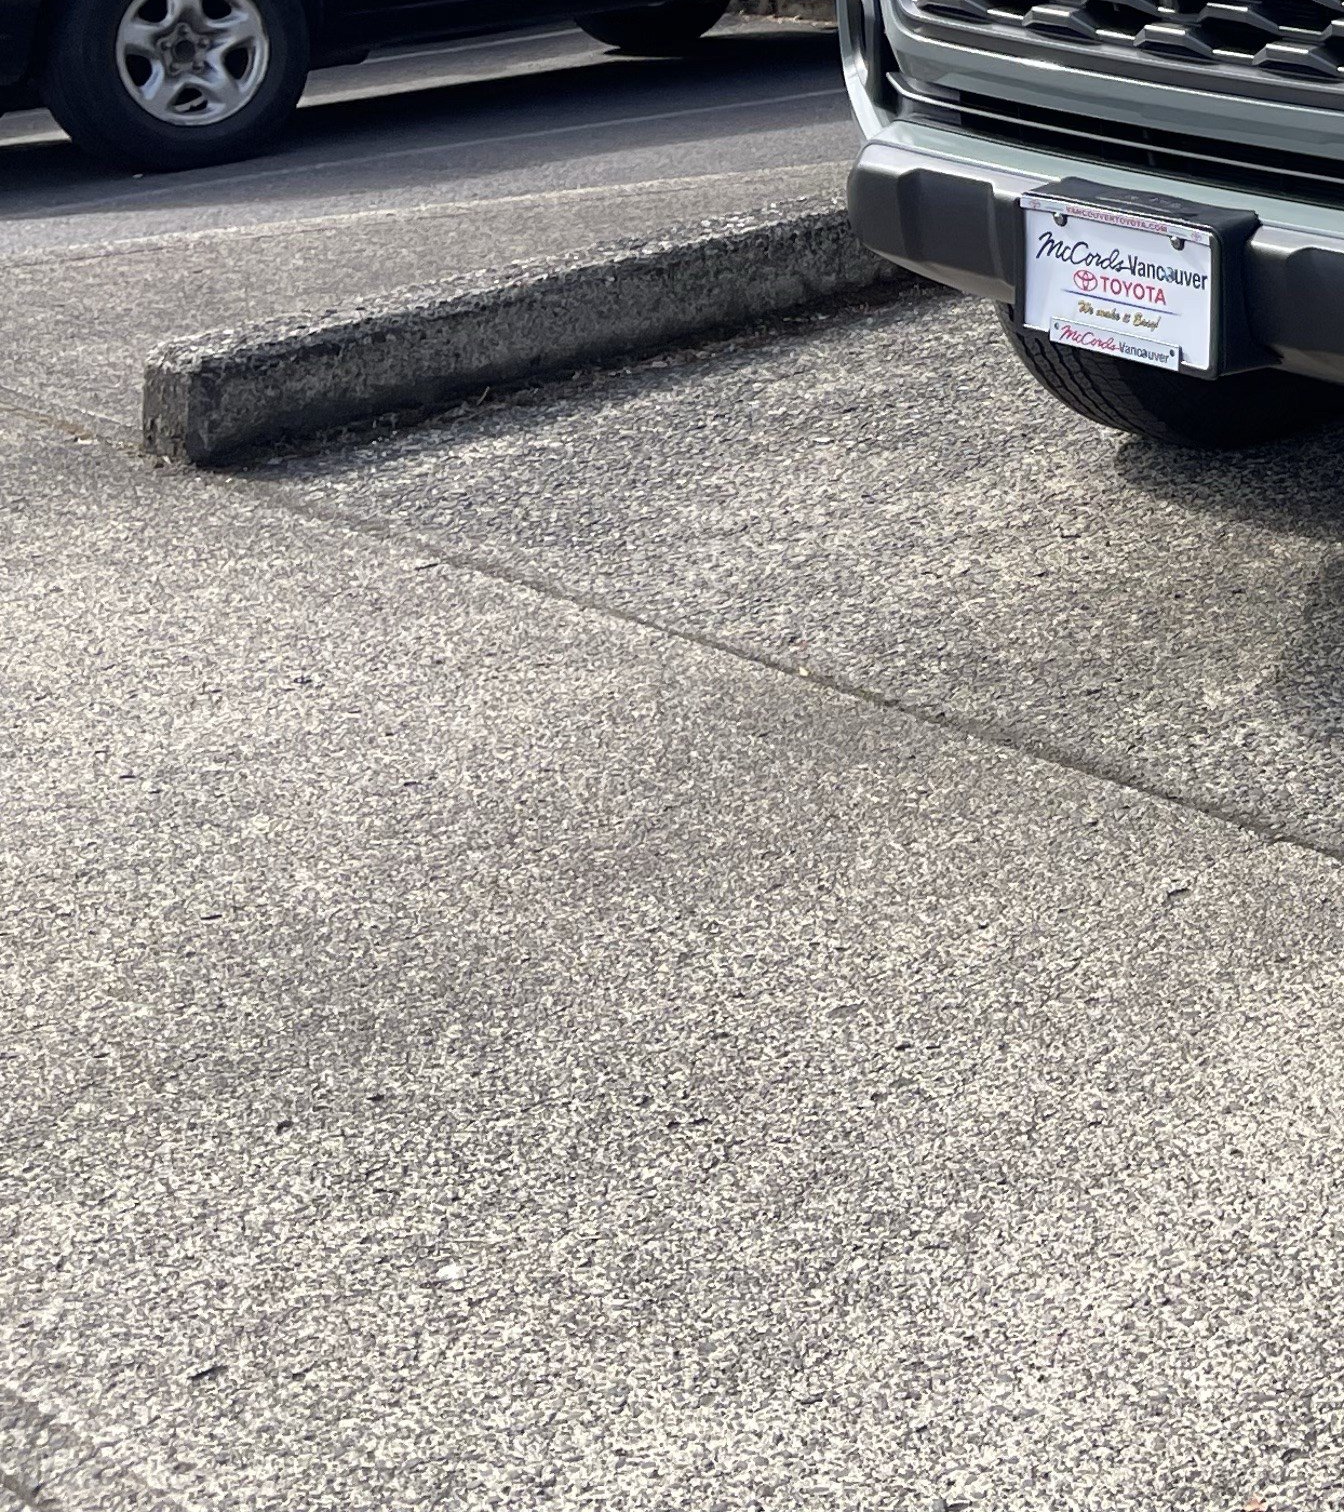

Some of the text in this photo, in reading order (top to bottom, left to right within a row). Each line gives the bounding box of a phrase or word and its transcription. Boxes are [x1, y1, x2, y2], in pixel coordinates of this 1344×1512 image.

[1065, 205, 1168, 233] VANCOUVERTOYOTA.COM
[1127, 254, 1208, 290] Vancouver
[1100, 275, 1167, 306] TOYOTA
[1119, 341, 1169, 364] Vancouver
